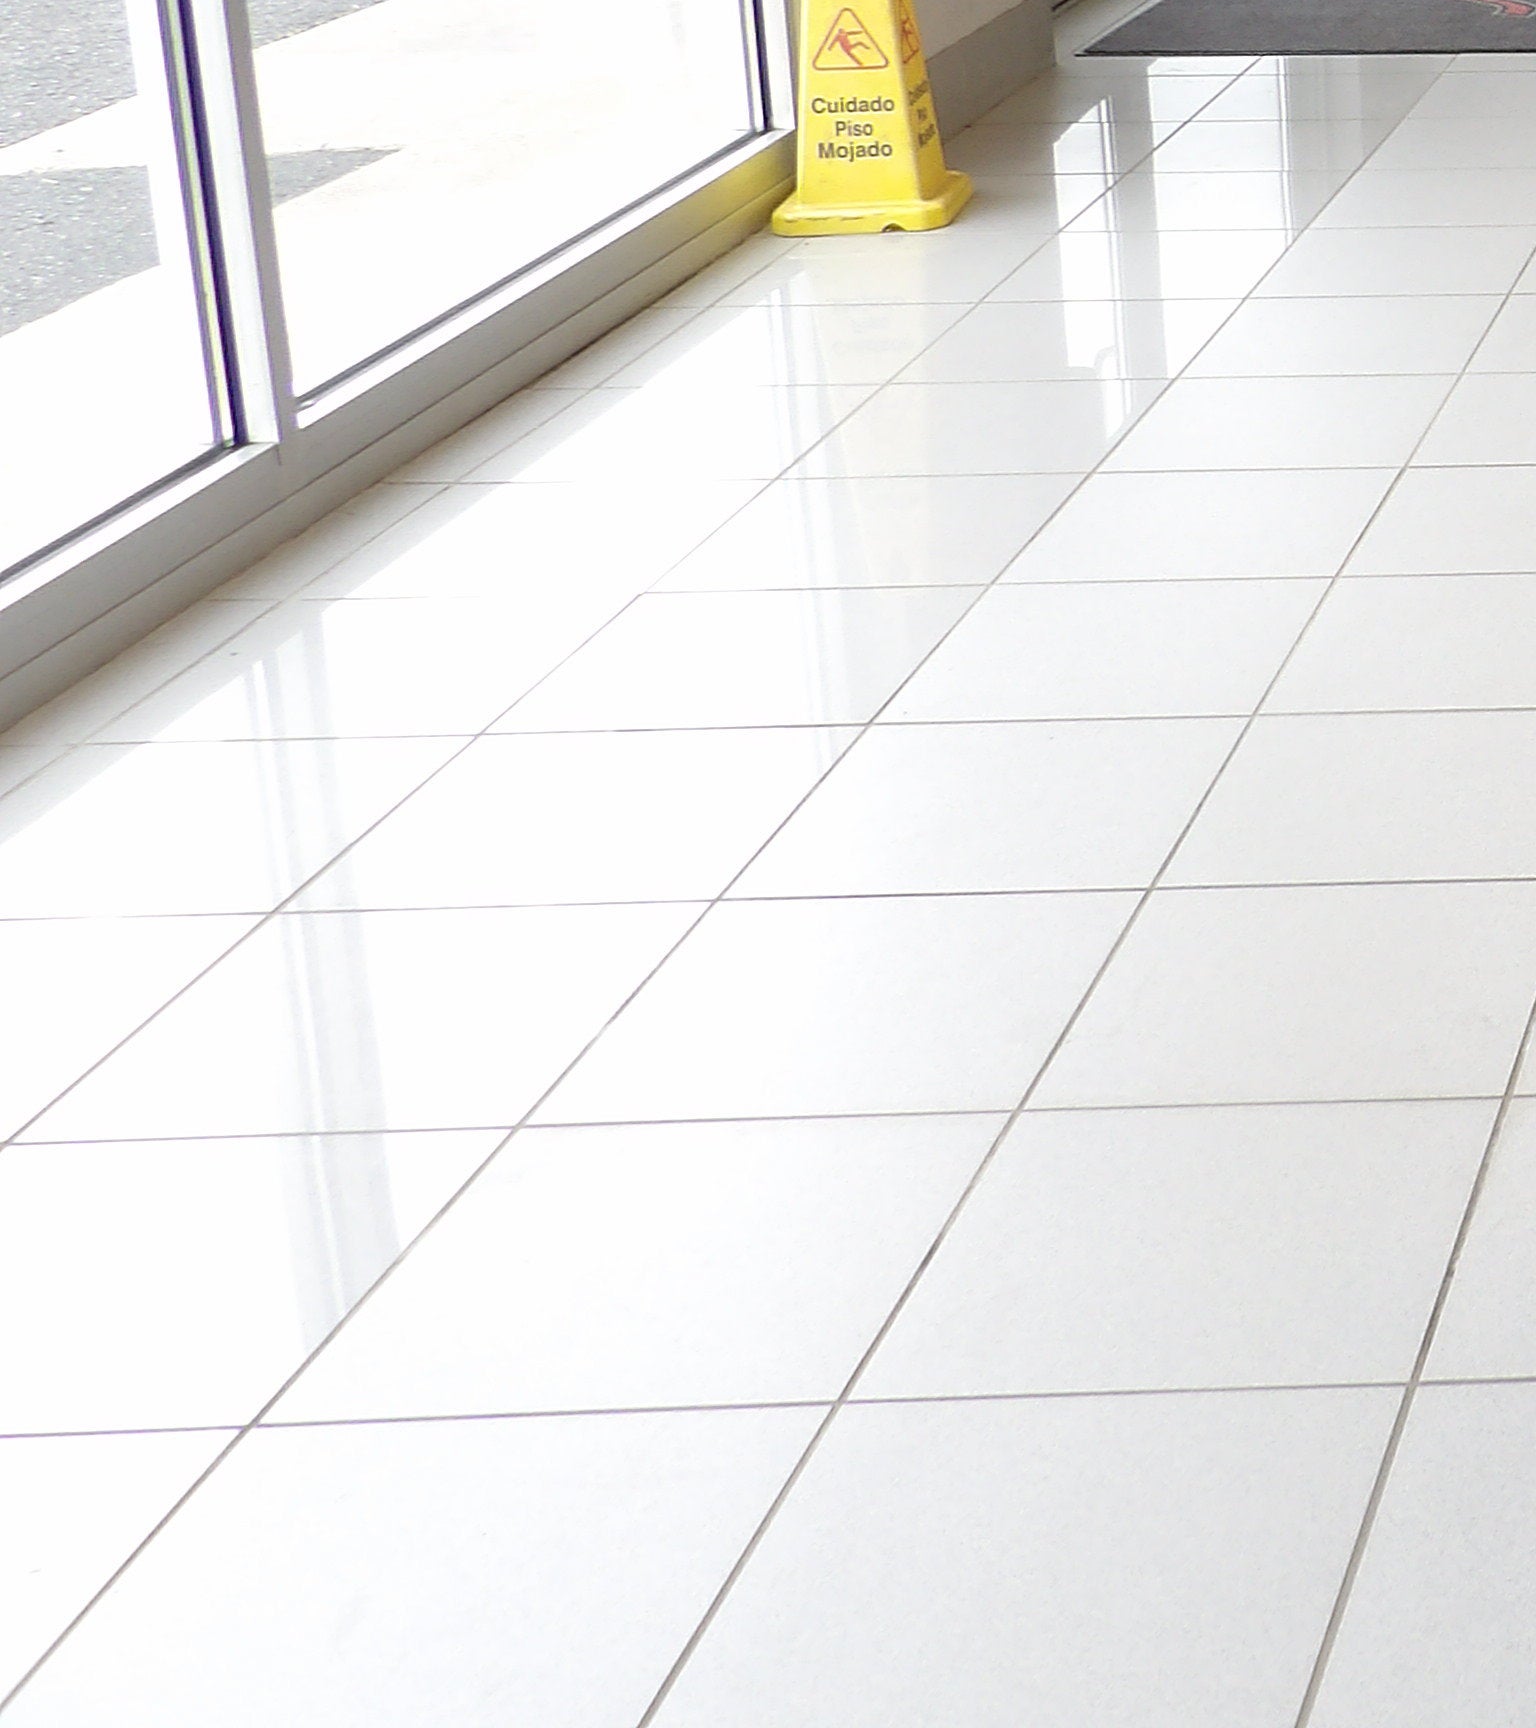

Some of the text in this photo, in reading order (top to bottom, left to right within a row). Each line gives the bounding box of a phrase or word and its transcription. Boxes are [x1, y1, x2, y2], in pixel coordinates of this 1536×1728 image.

[811, 96, 895, 114] Cuidado
[835, 120, 873, 137] Piso
[818, 141, 893, 163] Mojado
